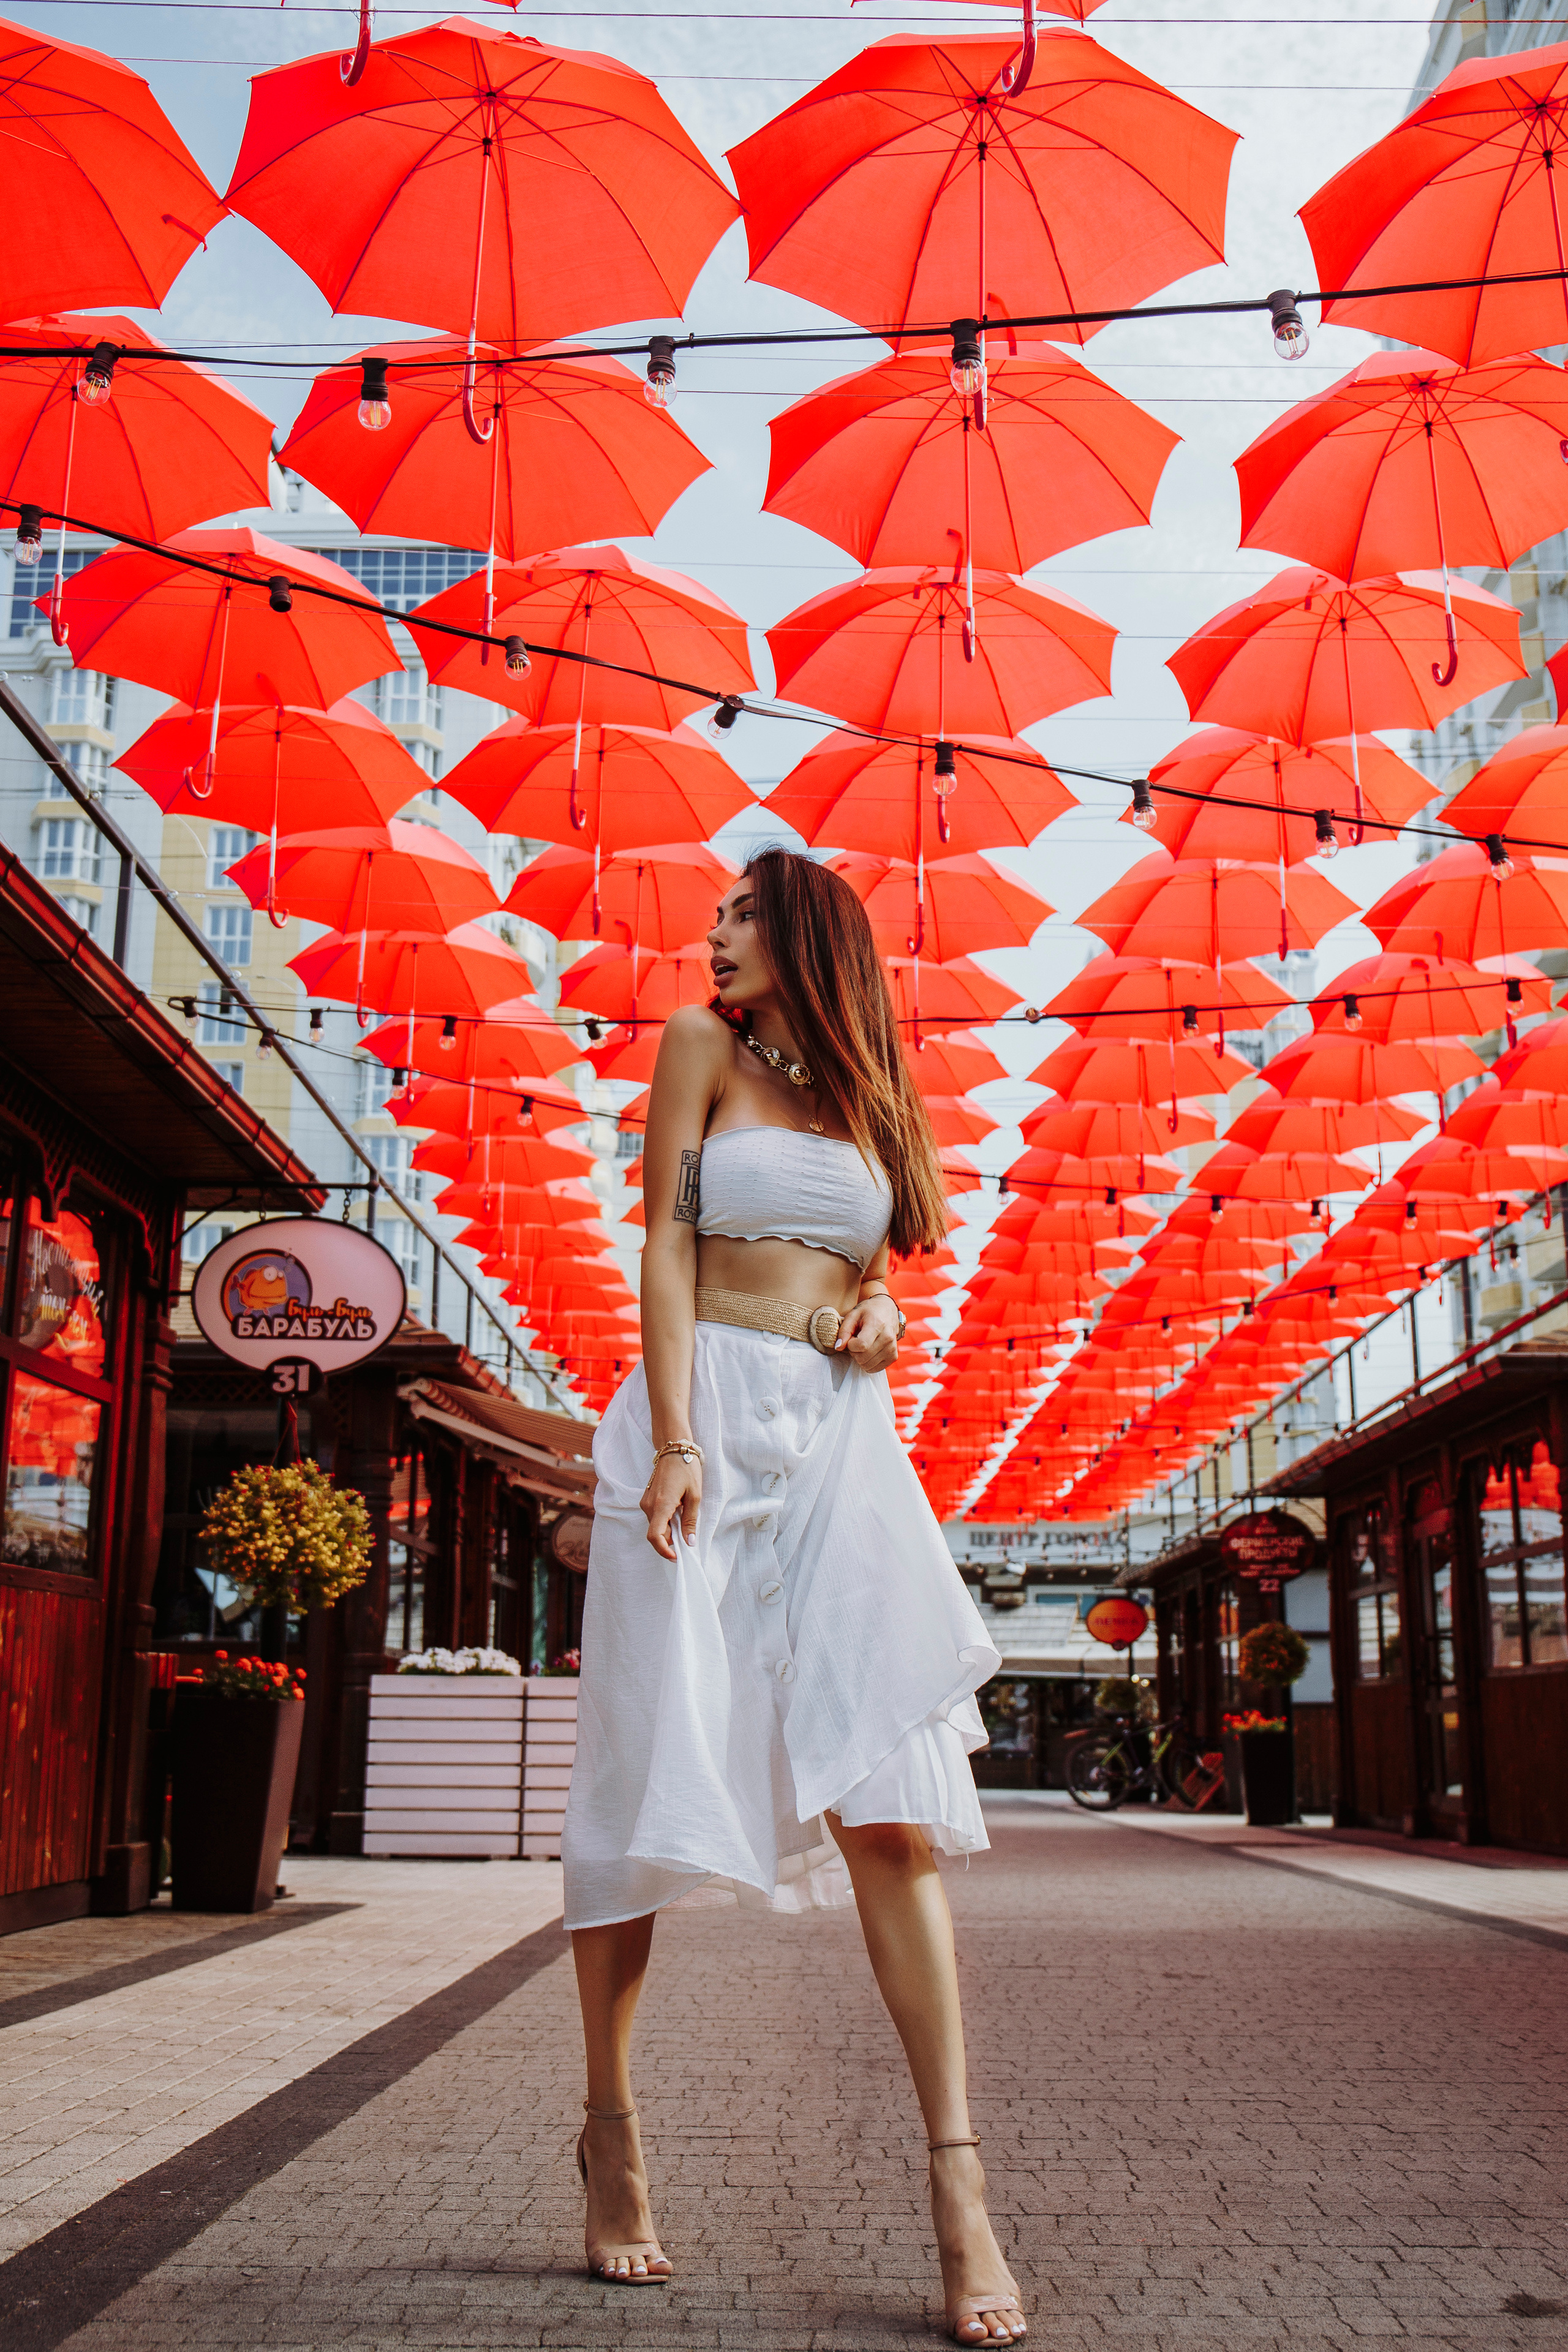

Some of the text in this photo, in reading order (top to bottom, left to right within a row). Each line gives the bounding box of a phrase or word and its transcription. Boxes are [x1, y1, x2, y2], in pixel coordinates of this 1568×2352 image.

[238, 1317, 373, 1338] БАРАБУЛЬ
[272, 1364, 311, 1392] 31
[970, 1531, 1039, 1547] ЦЕНТР
[1259, 1579, 1280, 1592] 22
